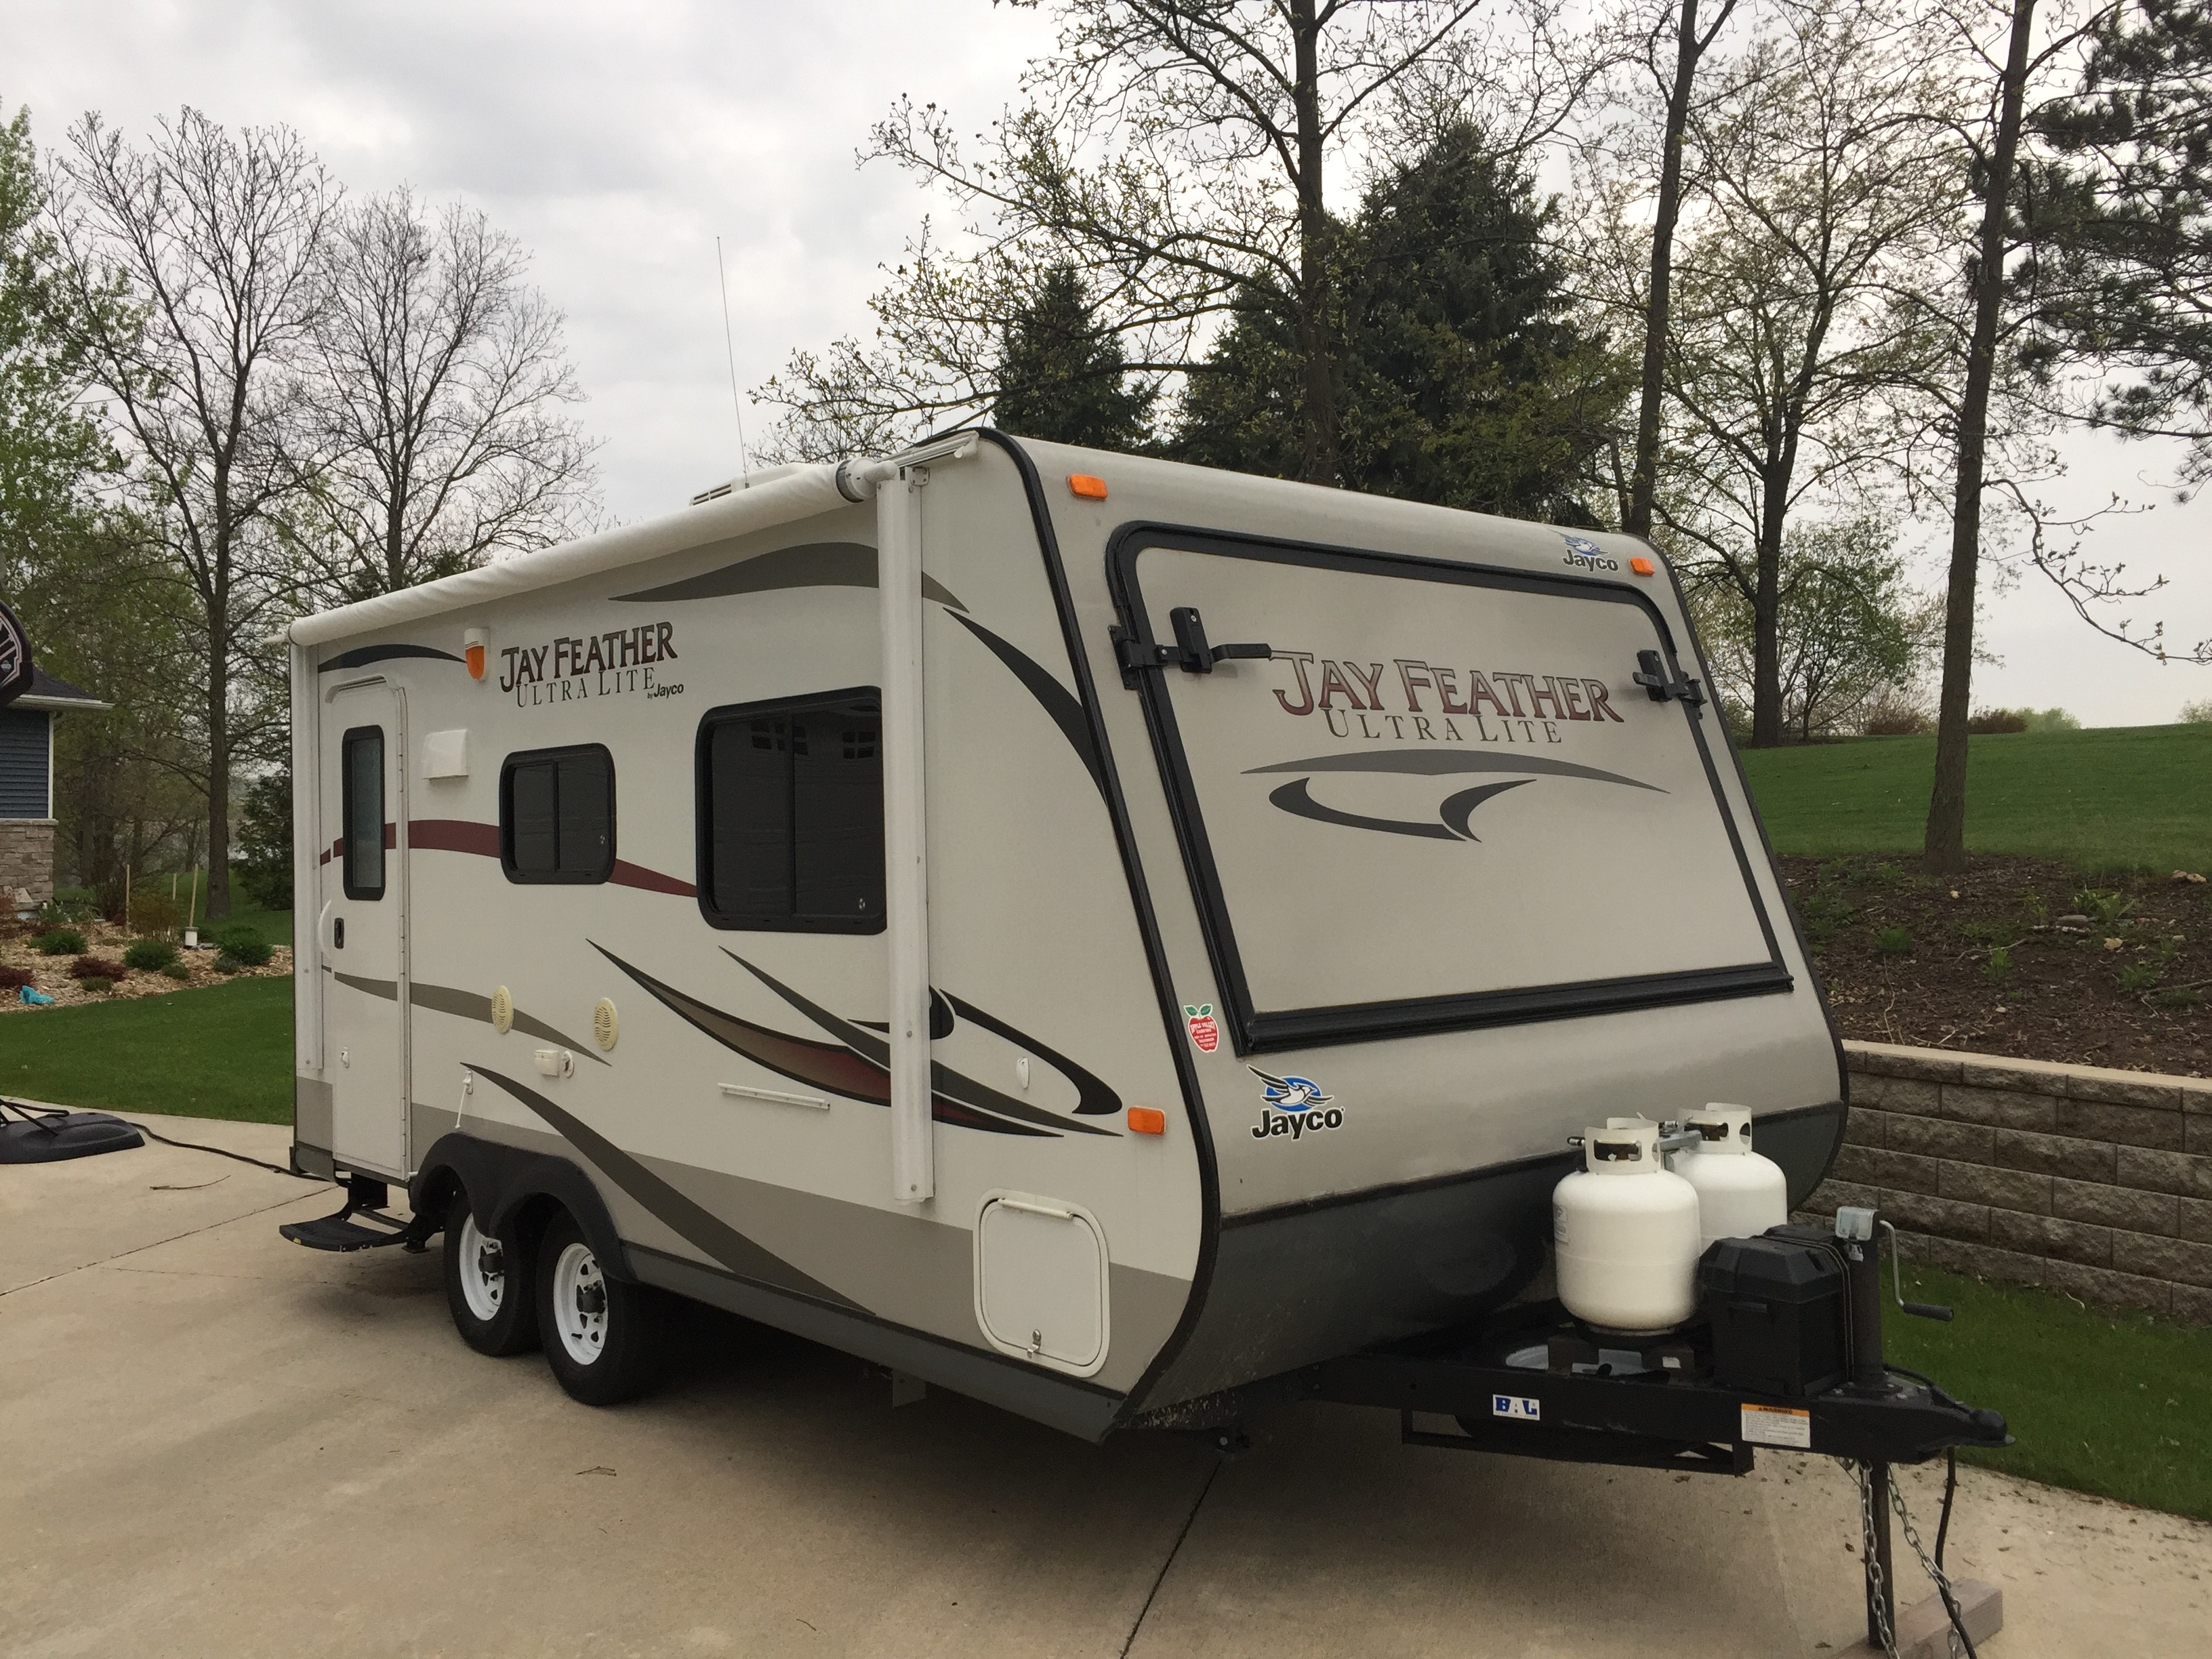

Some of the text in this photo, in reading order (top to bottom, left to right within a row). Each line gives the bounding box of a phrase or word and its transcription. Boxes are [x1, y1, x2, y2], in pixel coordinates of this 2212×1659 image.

[1563, 550, 1618, 571] Jayco
[500, 621, 678, 693] JAY FEATHER
[516, 668, 655, 708] ULTRA LITE
[653, 683, 684, 699] Jayco
[1270, 650, 1624, 722] JAY FEATHER
[1320, 708, 1561, 743] ULTRA LITE
[1251, 1108, 1343, 1141] Jayco
